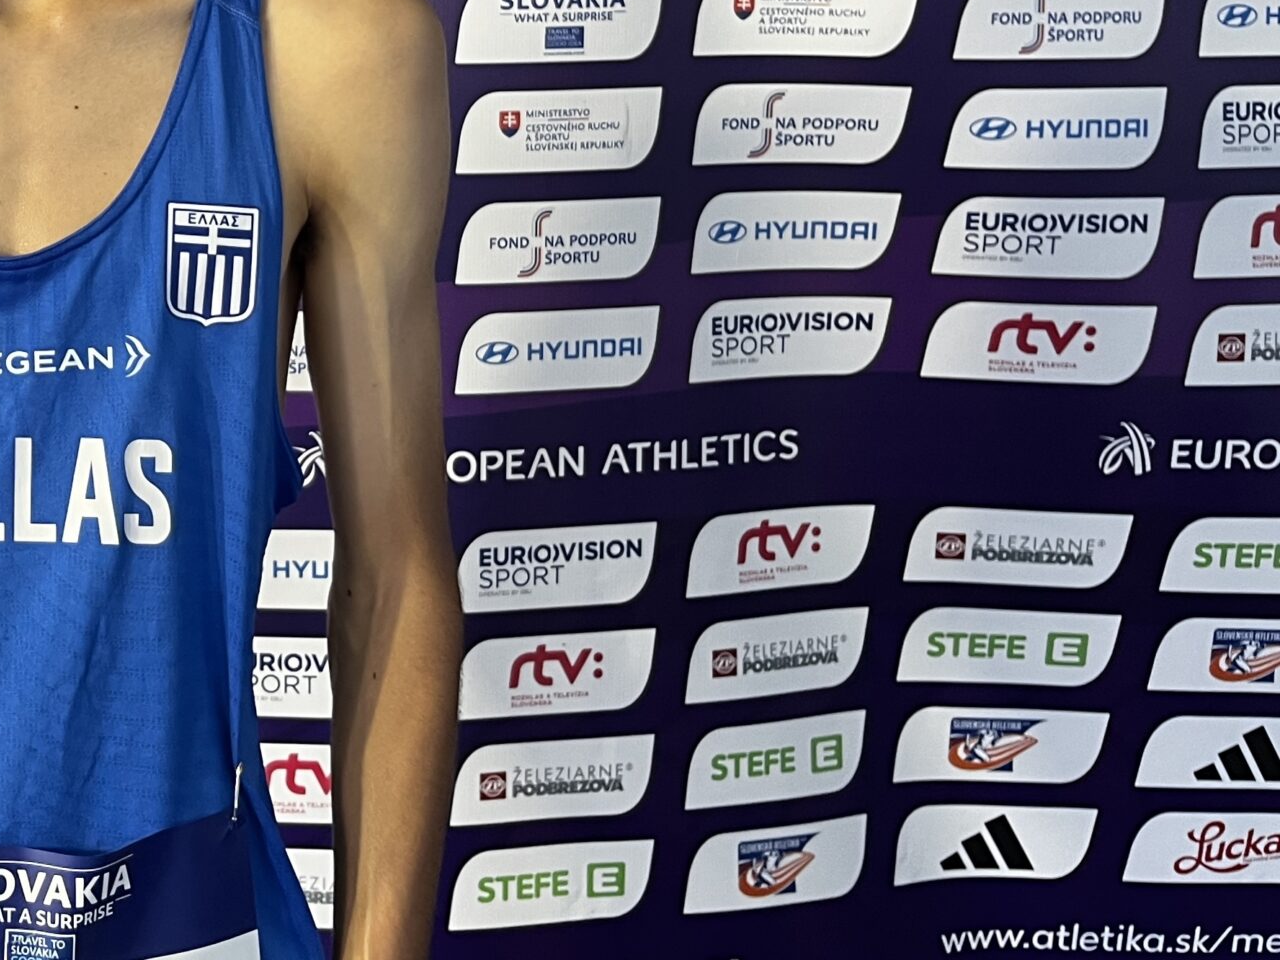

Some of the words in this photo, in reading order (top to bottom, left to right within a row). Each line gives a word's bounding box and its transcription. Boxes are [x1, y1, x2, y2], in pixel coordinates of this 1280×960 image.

[514, 12, 549, 23] WHAT
[552, 12, 560, 22] A
[562, 11, 613, 22] SURPRISE
[991, 12, 1032, 26] FOND
[1048, 11, 1069, 25] NA
[1073, 11, 1142, 25] PODPORU
[1047, 27, 1104, 42] ŠPORTU
[721, 117, 760, 131] FOND
[775, 117, 798, 130] NA
[801, 117, 879, 131] PODPORU
[1026, 118, 1148, 139] HYUNDAI
[774, 132, 835, 147] ŠPORTU
[187, 212, 240, 228] ΕΛΛΑΣ
[754, 219, 878, 241] HYUNDAI
[489, 236, 529, 250] FOND
[544, 234, 565, 247] NA
[569, 231, 637, 247] PODPORU
[963, 234, 1062, 256] SPORT
[544, 250, 600, 265] ŠPORTU
[527, 337, 642, 361] HYUNDAI
[711, 334, 790, 358] SPORT
[602, 428, 800, 476] ATHLETICS
[479, 564, 565, 590] SPORT
[926, 631, 1027, 660] STEFE
[710, 747, 796, 781] STEFE
[477, 870, 569, 904] STEFE
[18, 908, 32, 923] A
[35, 903, 114, 929] SURPRISE
[11, 934, 48, 948] TRAVEL
[52, 939, 66, 950] TO
[11, 946, 59, 959] SLOVAKIA
